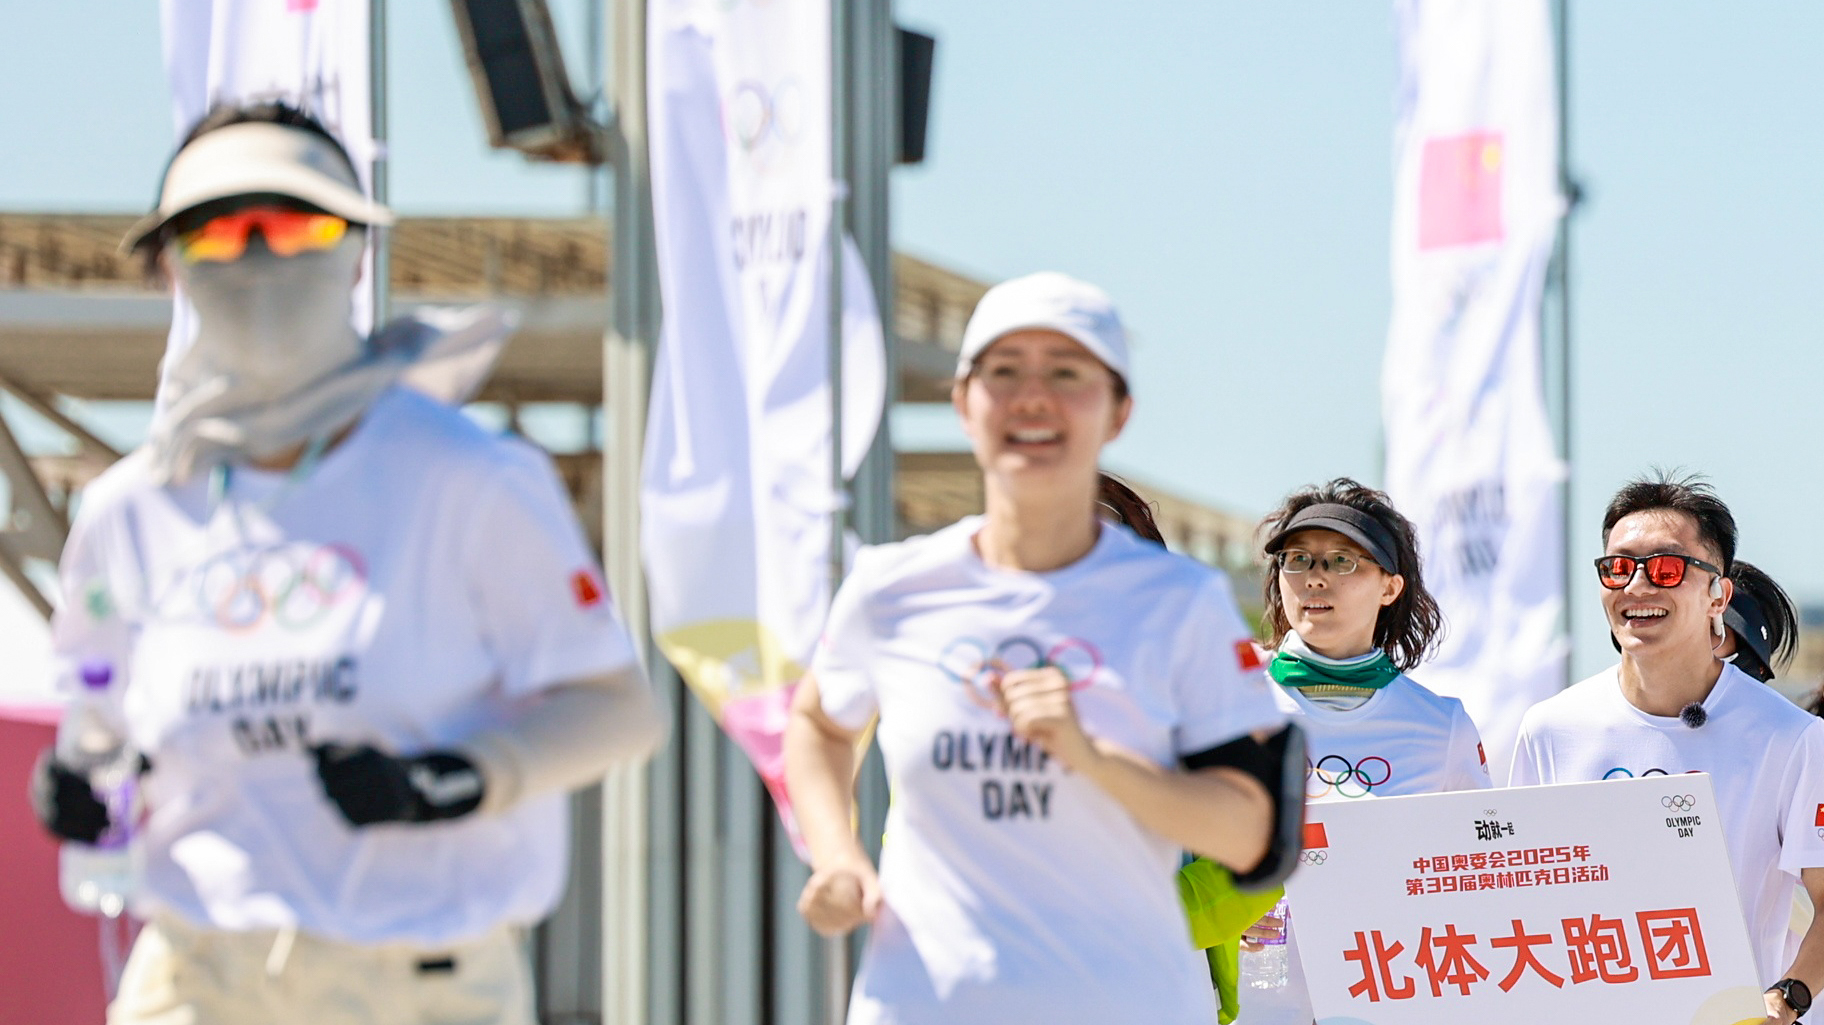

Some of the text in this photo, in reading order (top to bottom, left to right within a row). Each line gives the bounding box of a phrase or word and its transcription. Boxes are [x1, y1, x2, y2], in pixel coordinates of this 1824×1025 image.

[981, 779, 1054, 820] DAY
[1666, 816, 1701, 828] OLYMPIC
[1678, 828, 1694, 838] DAY
[1412, 845, 1591, 874] 中国奥委会2025年
[1405, 864, 1609, 896] 第39届奥林匹克日活动
[1342, 907, 1712, 1003] 北体大跑团
